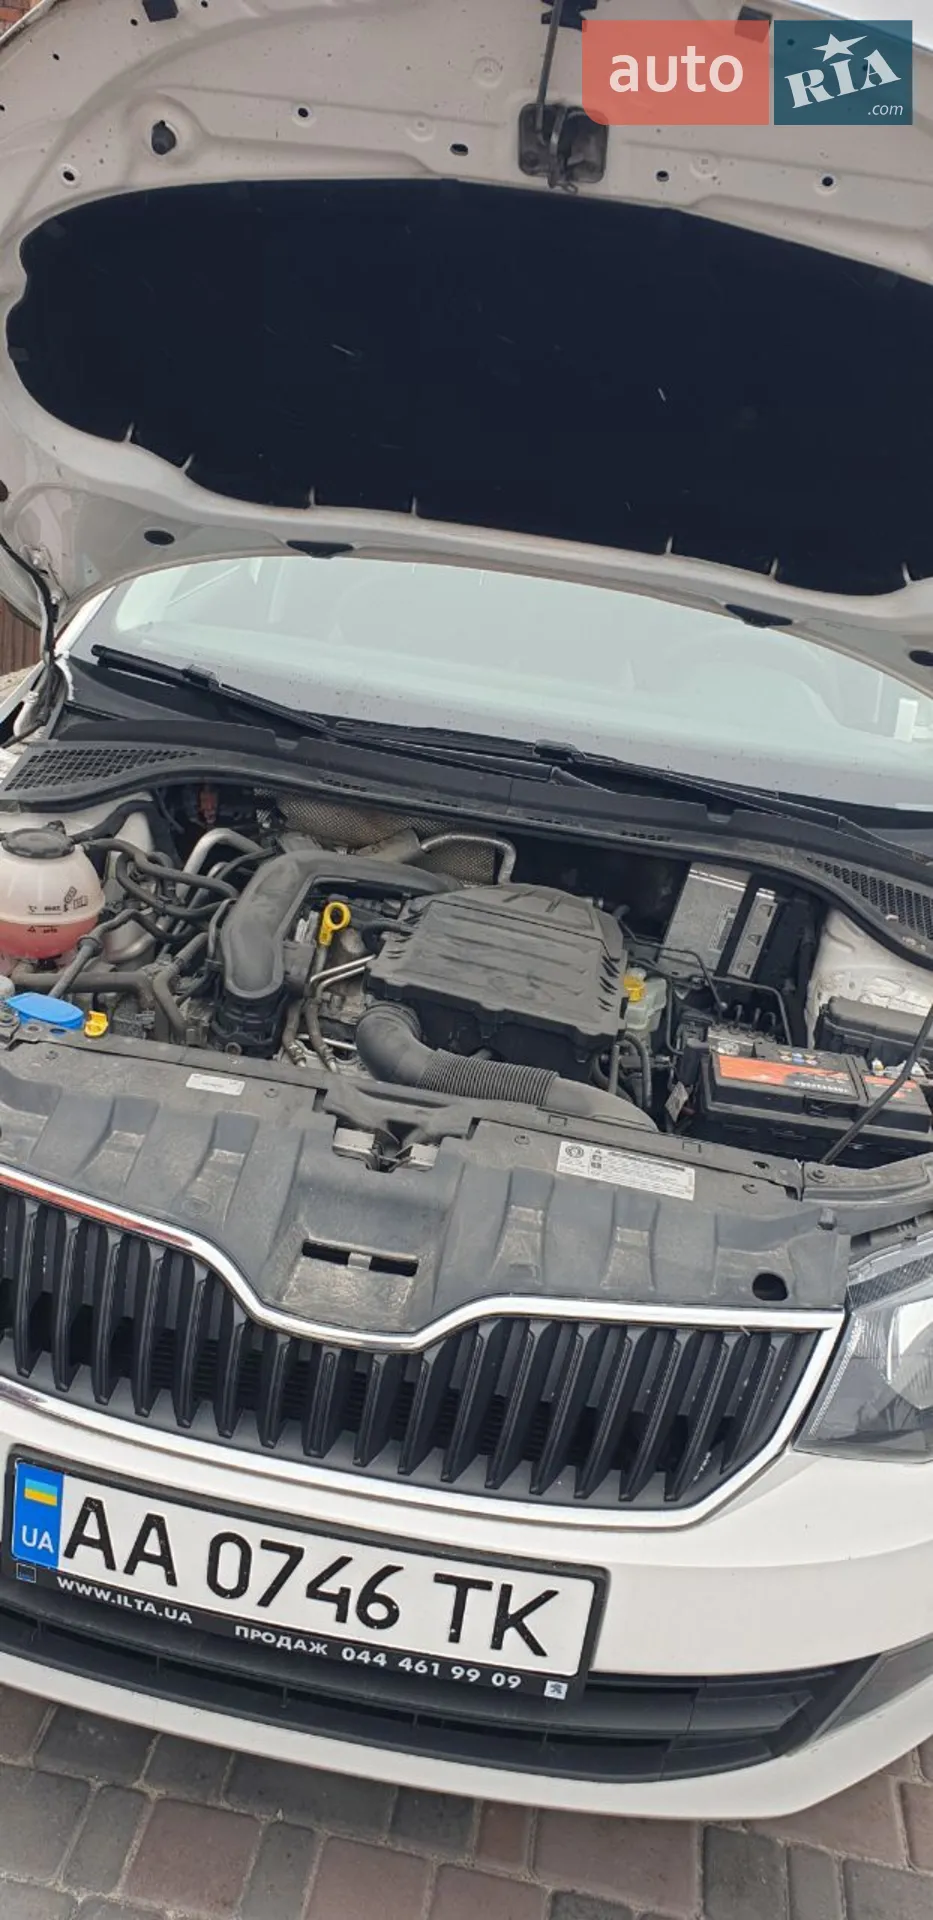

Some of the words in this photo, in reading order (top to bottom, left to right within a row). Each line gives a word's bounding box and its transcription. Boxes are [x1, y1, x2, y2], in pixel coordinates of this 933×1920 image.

[21, 1524, 54, 1553] UA
[56, 1576, 193, 1624] WWW.ILTA.UA
[63, 1496, 178, 1587] AA
[206, 1531, 404, 1630] 0746
[433, 1572, 559, 1657] TK
[235, 1625, 328, 1656] ПРОДАЖ
[341, 1647, 387, 1667] 044
[398, 1656, 440, 1676] 461
[451, 1665, 481, 1683] 99
[491, 1672, 522, 1689] 09
